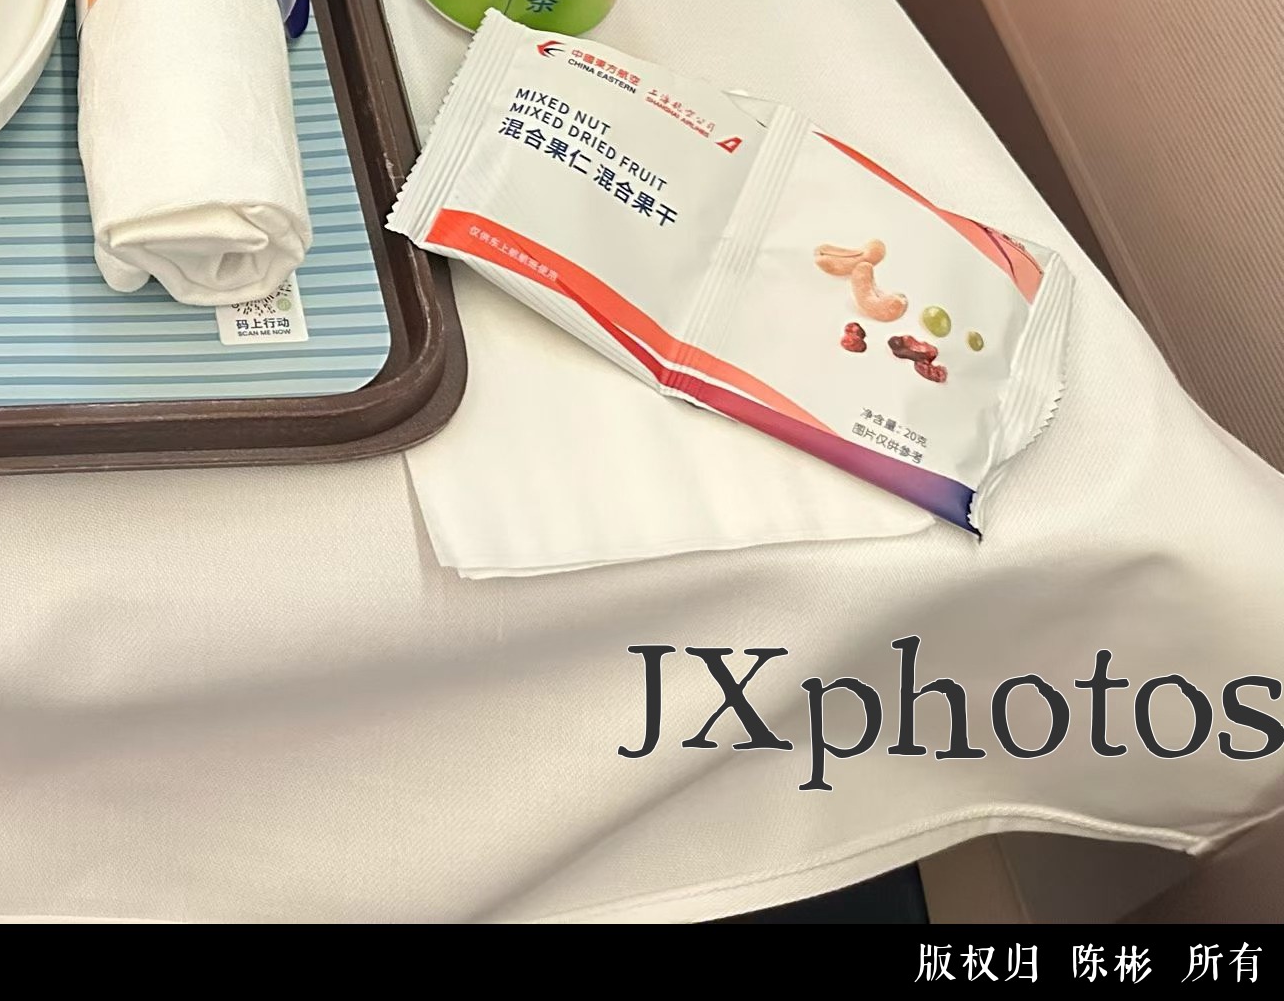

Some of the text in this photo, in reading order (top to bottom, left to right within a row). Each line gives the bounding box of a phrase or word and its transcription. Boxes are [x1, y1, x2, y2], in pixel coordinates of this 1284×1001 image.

[567, 58, 637, 94] CHINA EASTERN
[571, 49, 641, 87] 中國東方航空
[515, 88, 612, 136] MIXED NUT
[645, 95, 710, 139] SHANGHAI AIRLINES
[509, 103, 668, 192] MIXED DRIED FRUIT
[498, 116, 678, 228] 混合果仁 混合果干
[235, 317, 290, 330] 码上行动
[237, 329, 259, 337] SCAN
[272, 328, 291, 336] NOW
[851, 422, 923, 464] 图片仅供参考
